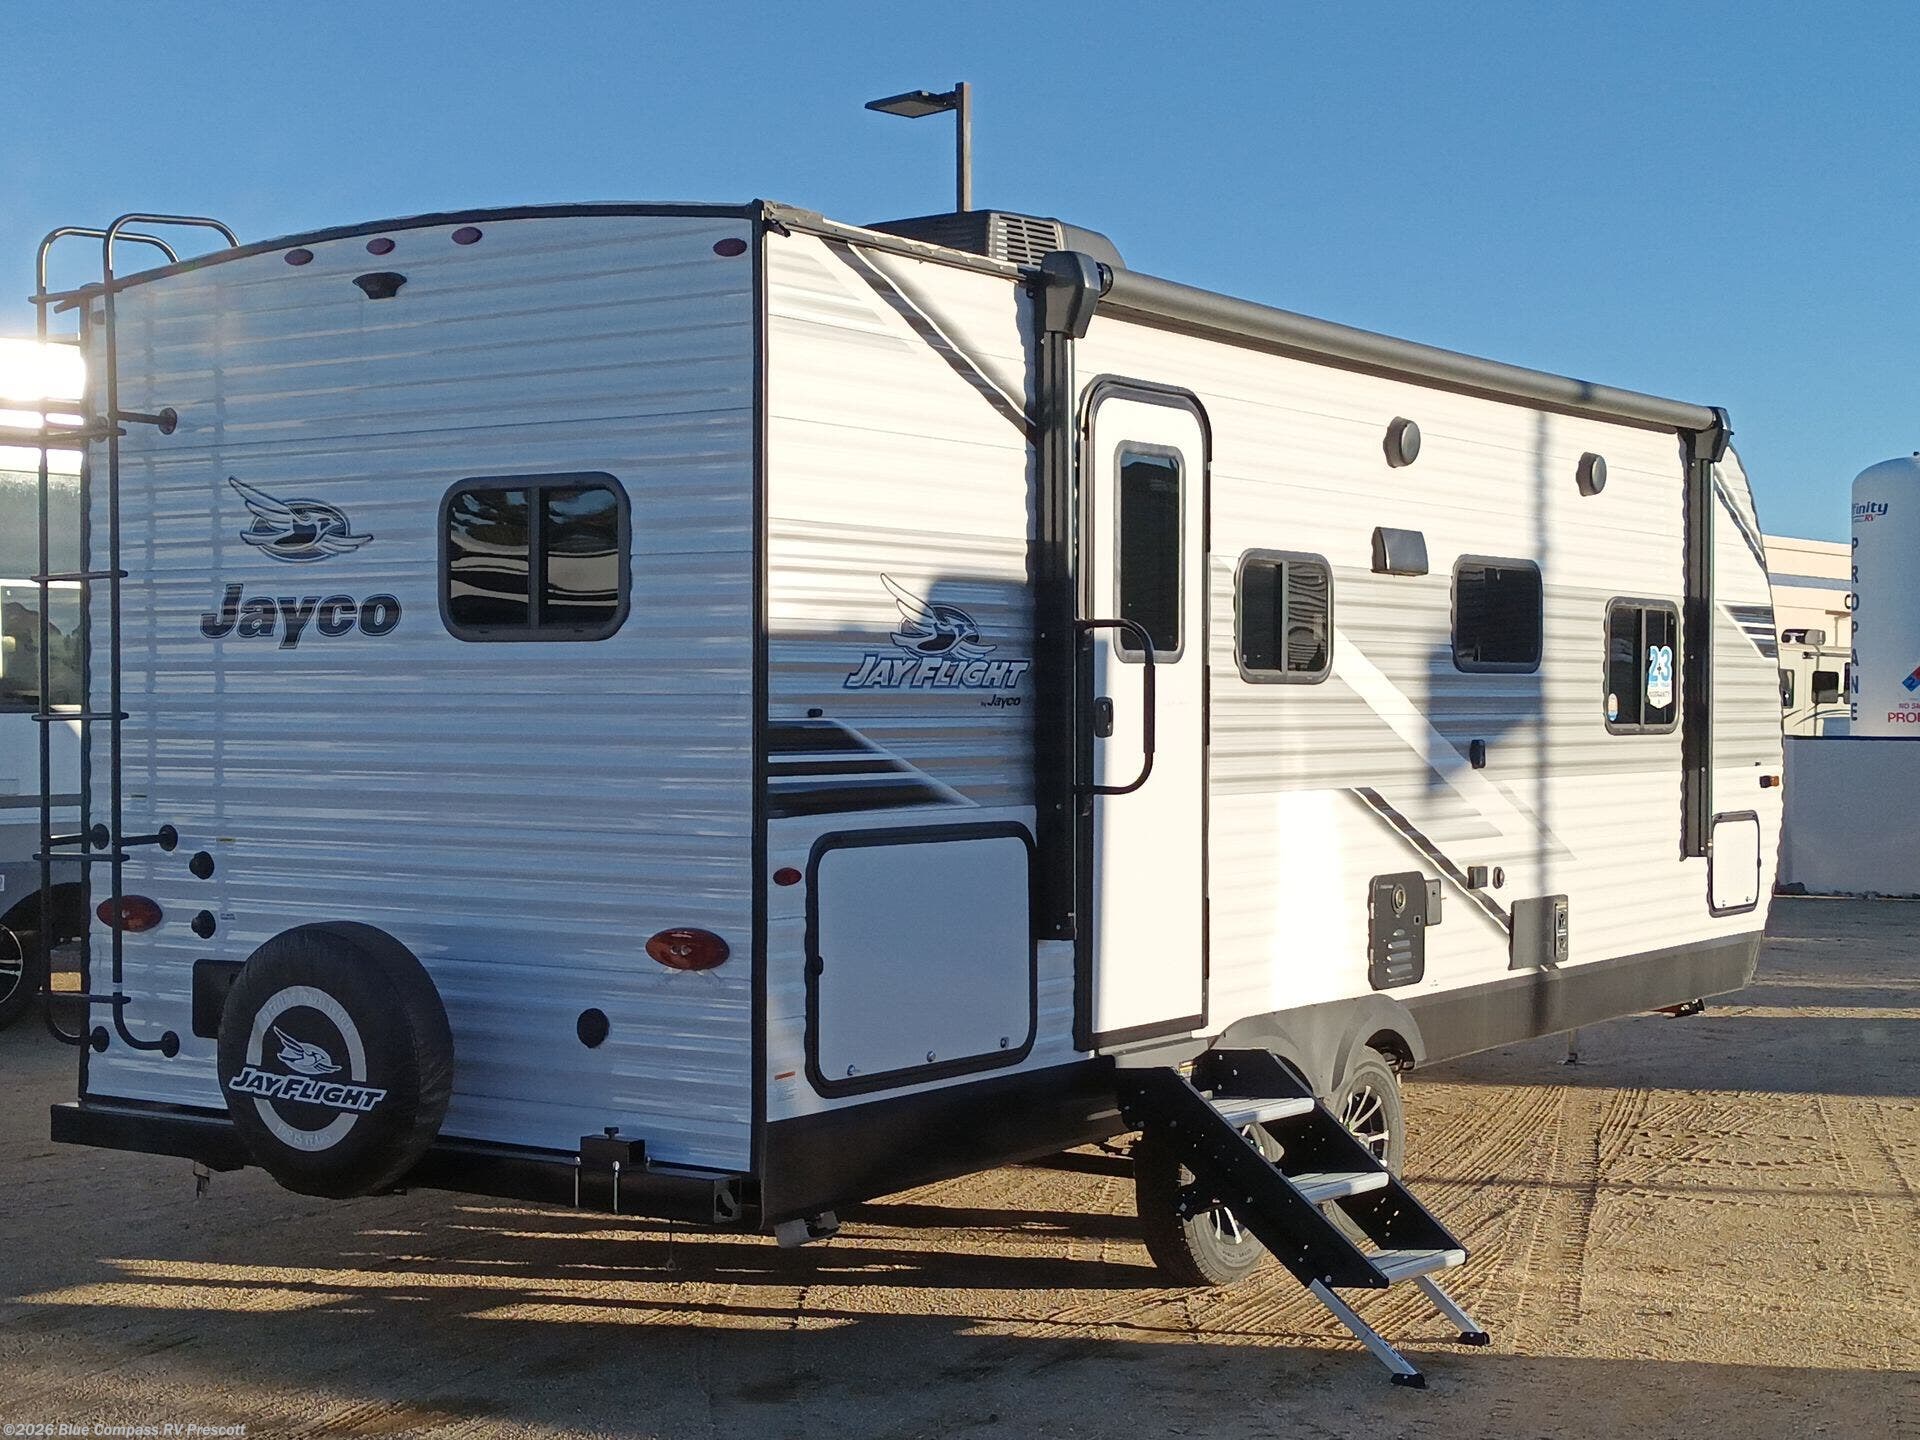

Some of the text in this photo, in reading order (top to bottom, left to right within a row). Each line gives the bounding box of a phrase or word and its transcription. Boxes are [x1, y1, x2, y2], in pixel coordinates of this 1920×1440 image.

[200, 583, 402, 649] Jayco
[987, 694, 1021, 709] Jayco
[1888, 711, 1920, 723] PRO
